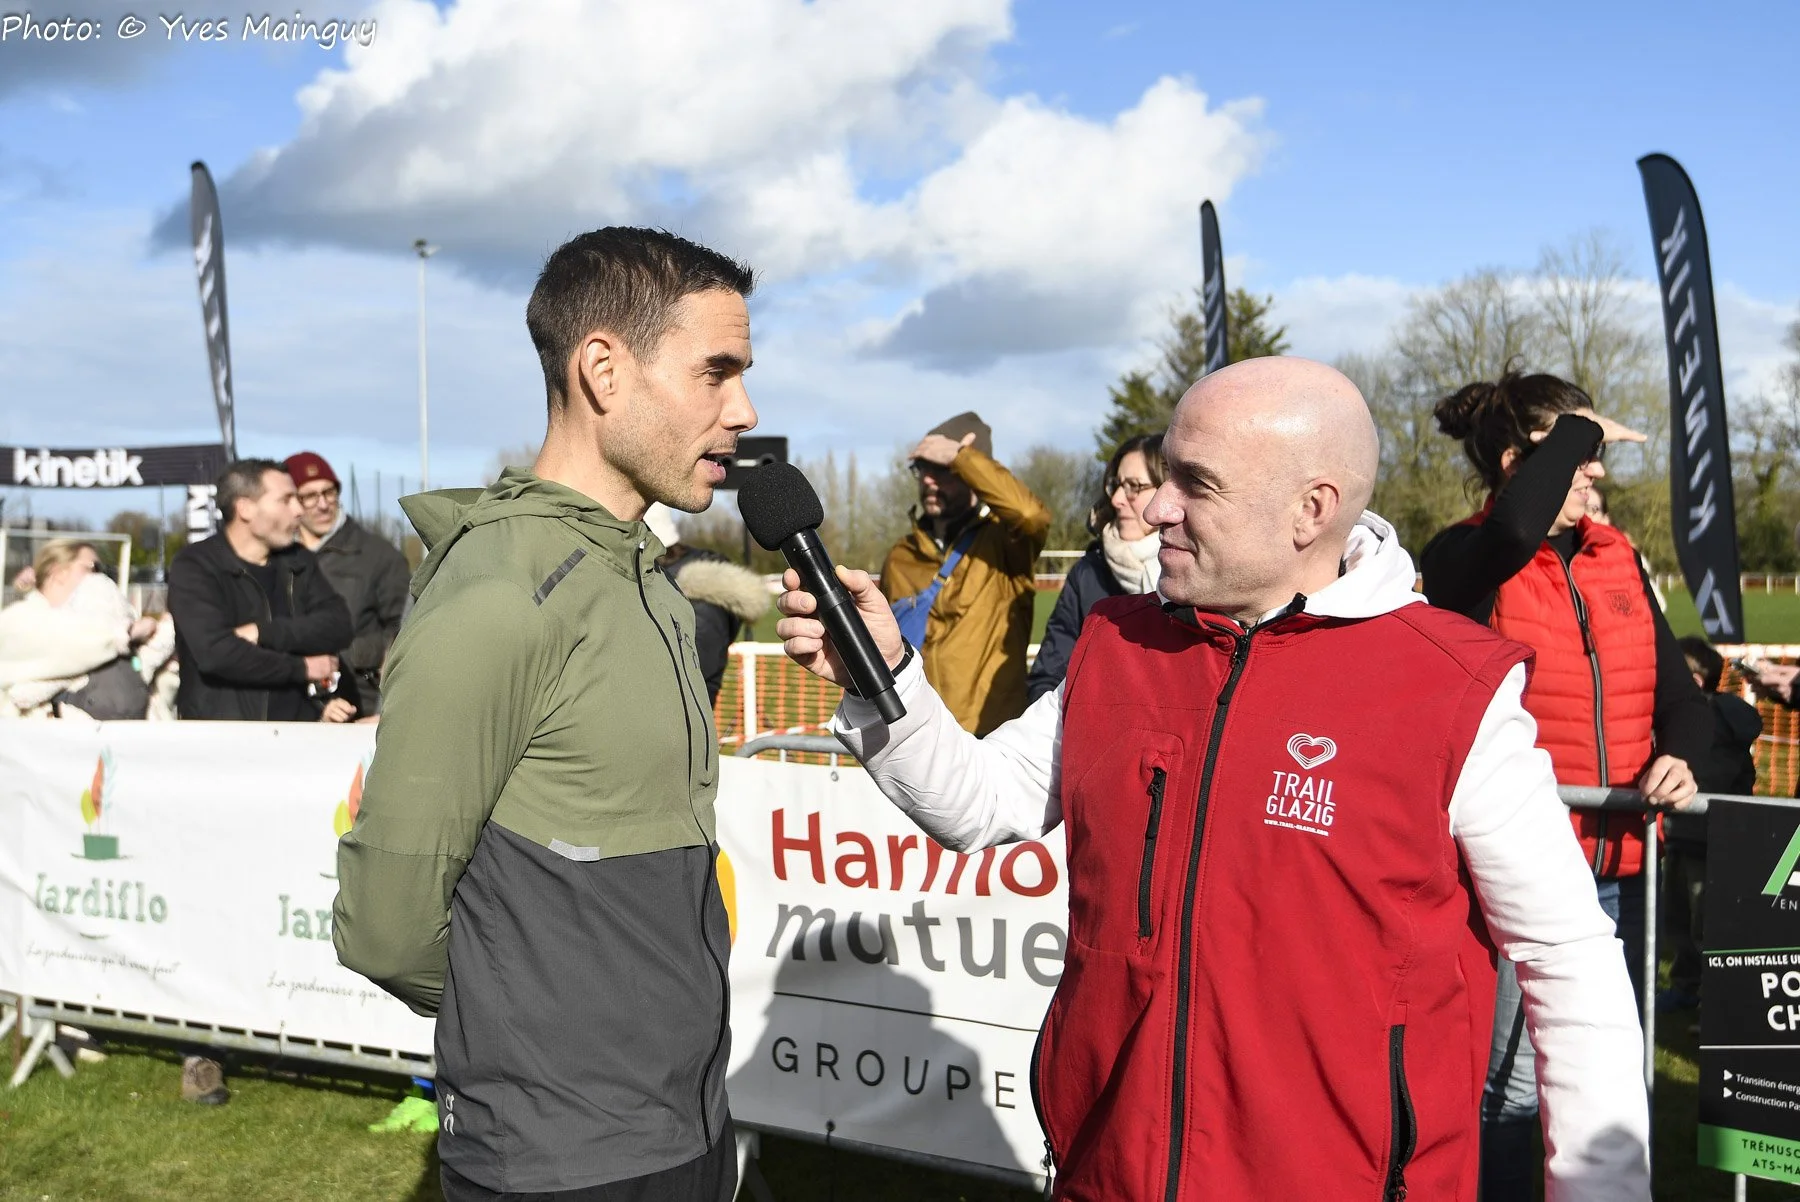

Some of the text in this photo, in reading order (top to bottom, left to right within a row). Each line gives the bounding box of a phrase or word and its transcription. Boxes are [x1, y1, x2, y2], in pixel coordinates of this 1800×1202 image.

[12, 447, 145, 488] kinetik
[1273, 770, 1337, 807] TRAIL
[1266, 794, 1335, 827] GLAZIG
[36, 872, 168, 923] Jardiflo
[765, 900, 1067, 987] mutue
[1708, 957, 1724, 968] ICI,
[1726, 956, 1742, 967] ON
[1744, 954, 1788, 967] INSTALLE
[771, 1037, 1016, 1109] GROUPE
[1735, 1073, 1776, 1089] Transition
[1735, 1091, 1787, 1109] Construction
